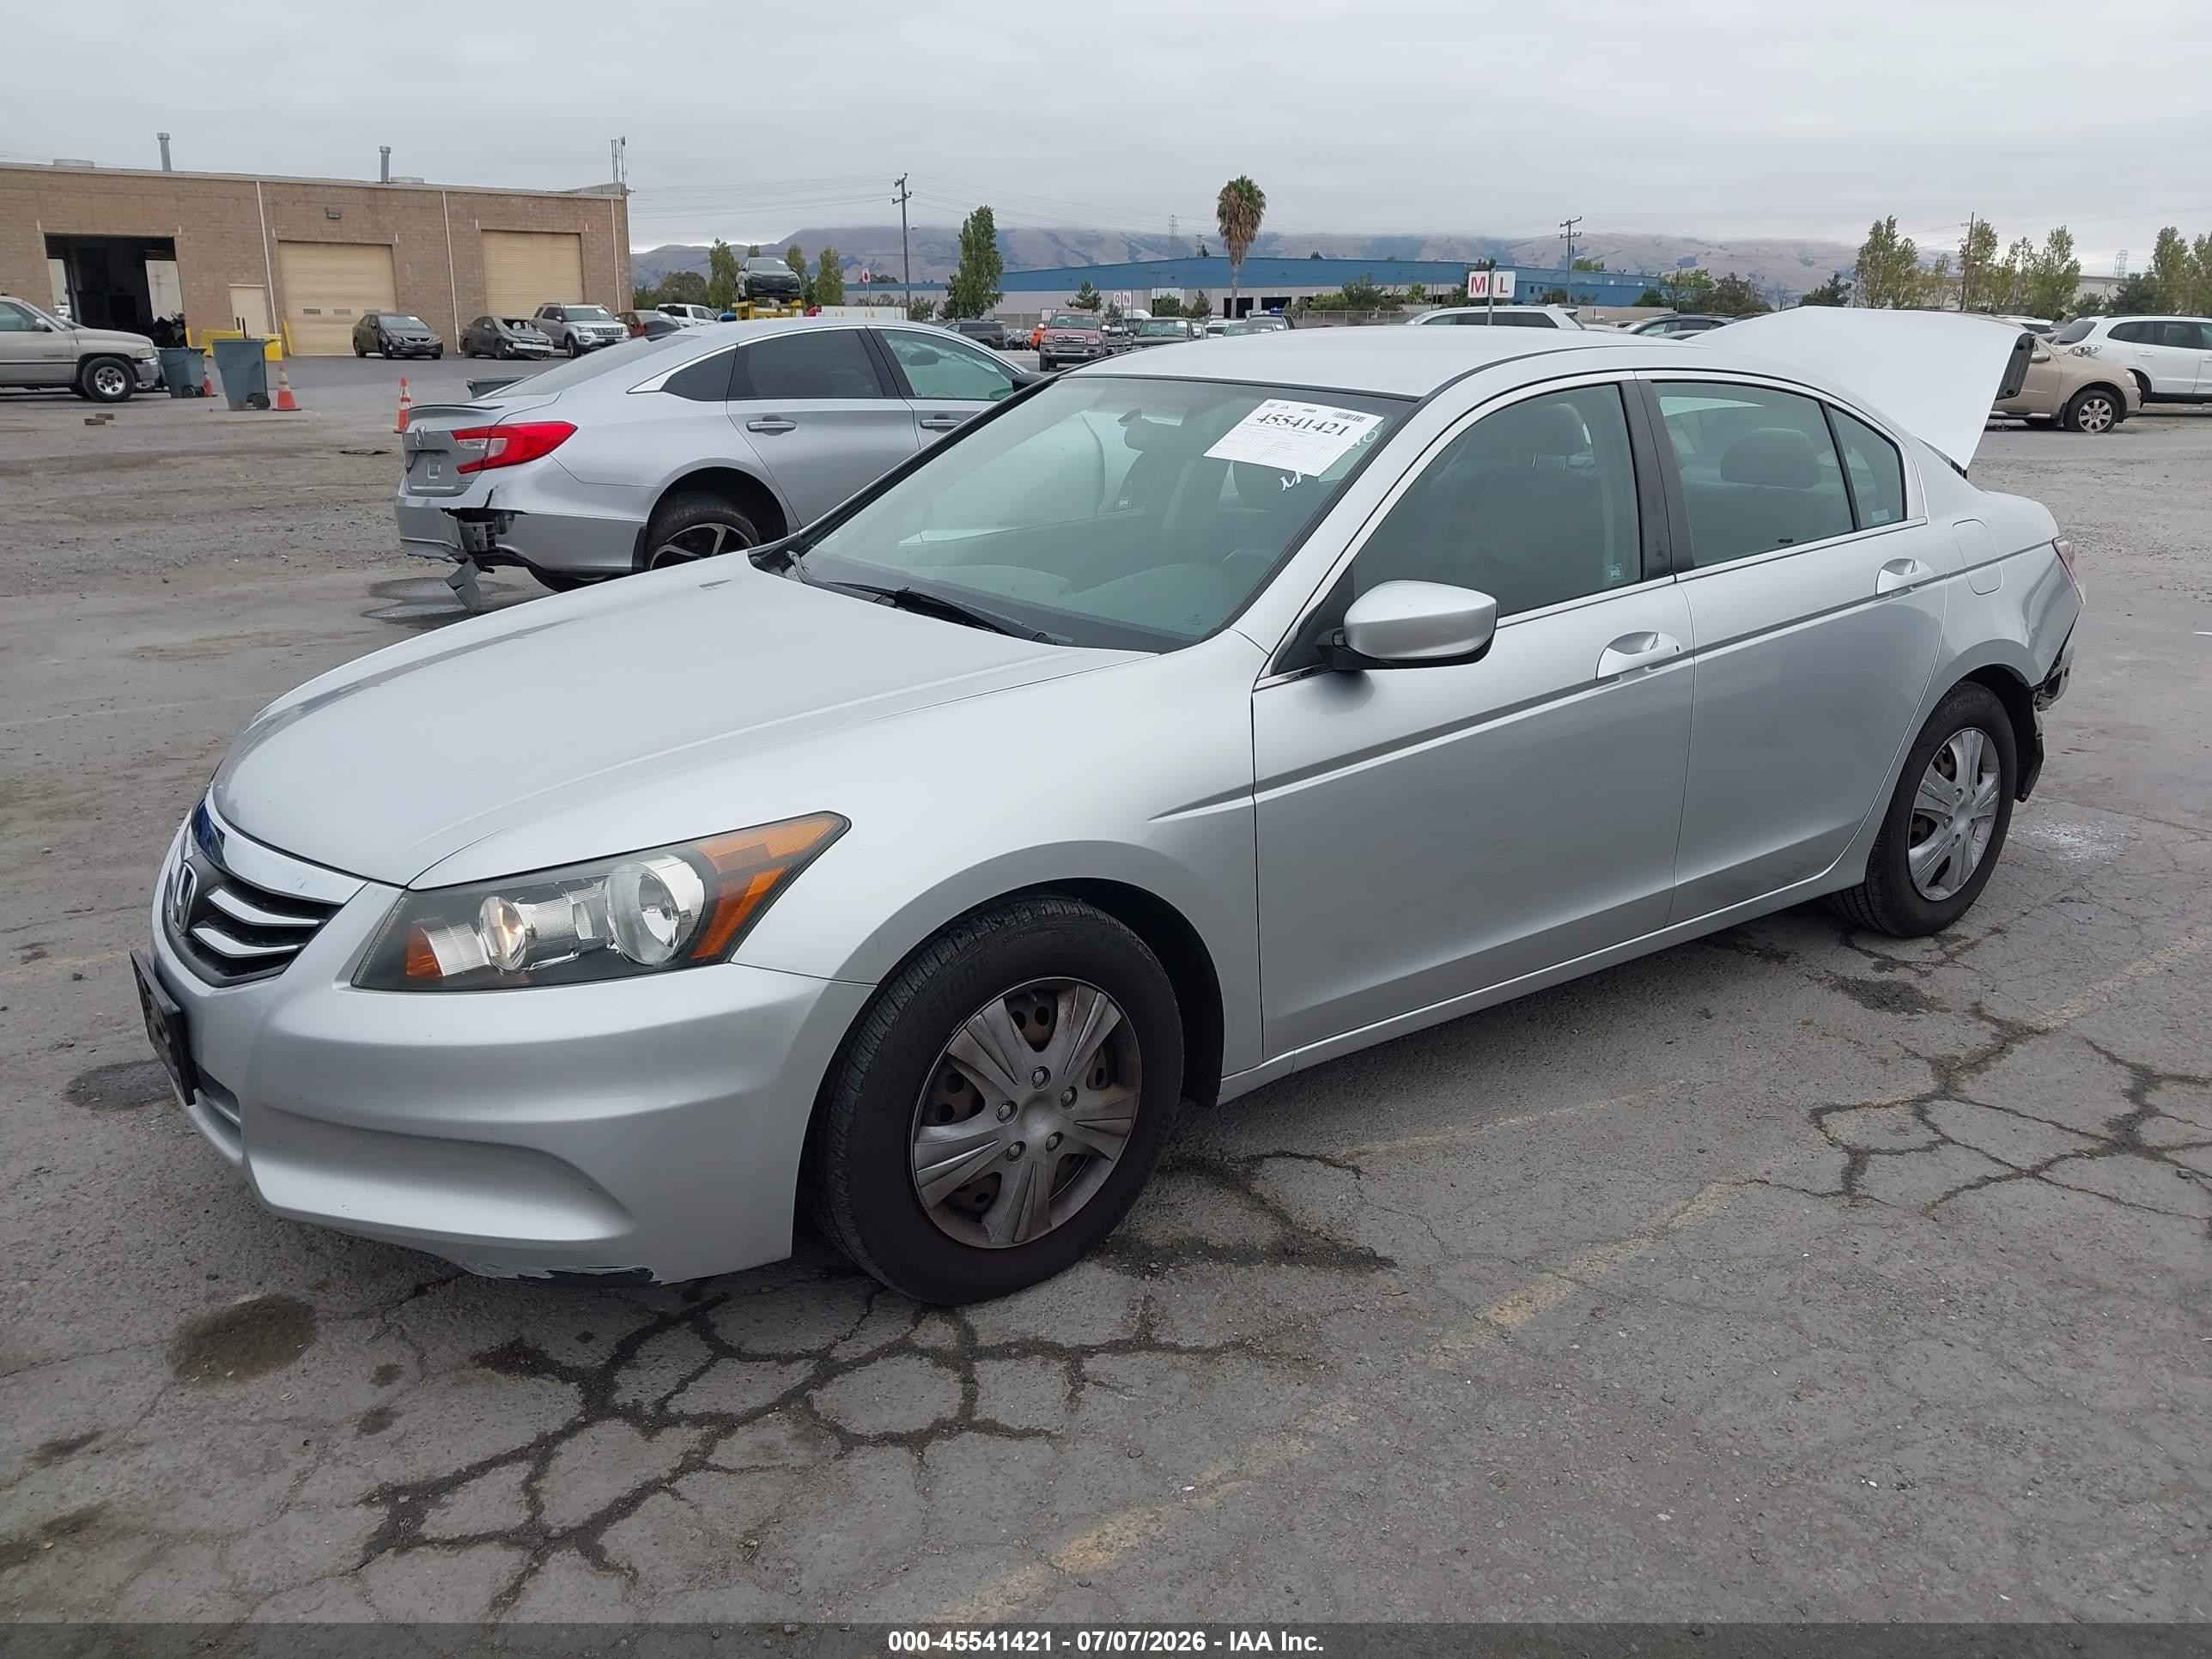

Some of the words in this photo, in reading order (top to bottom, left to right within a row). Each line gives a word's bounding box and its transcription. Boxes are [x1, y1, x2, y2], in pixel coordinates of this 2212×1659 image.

[1470, 276, 1486, 294] M
[1499, 276, 1509, 294] L
[1256, 412, 1351, 436] 45541421
